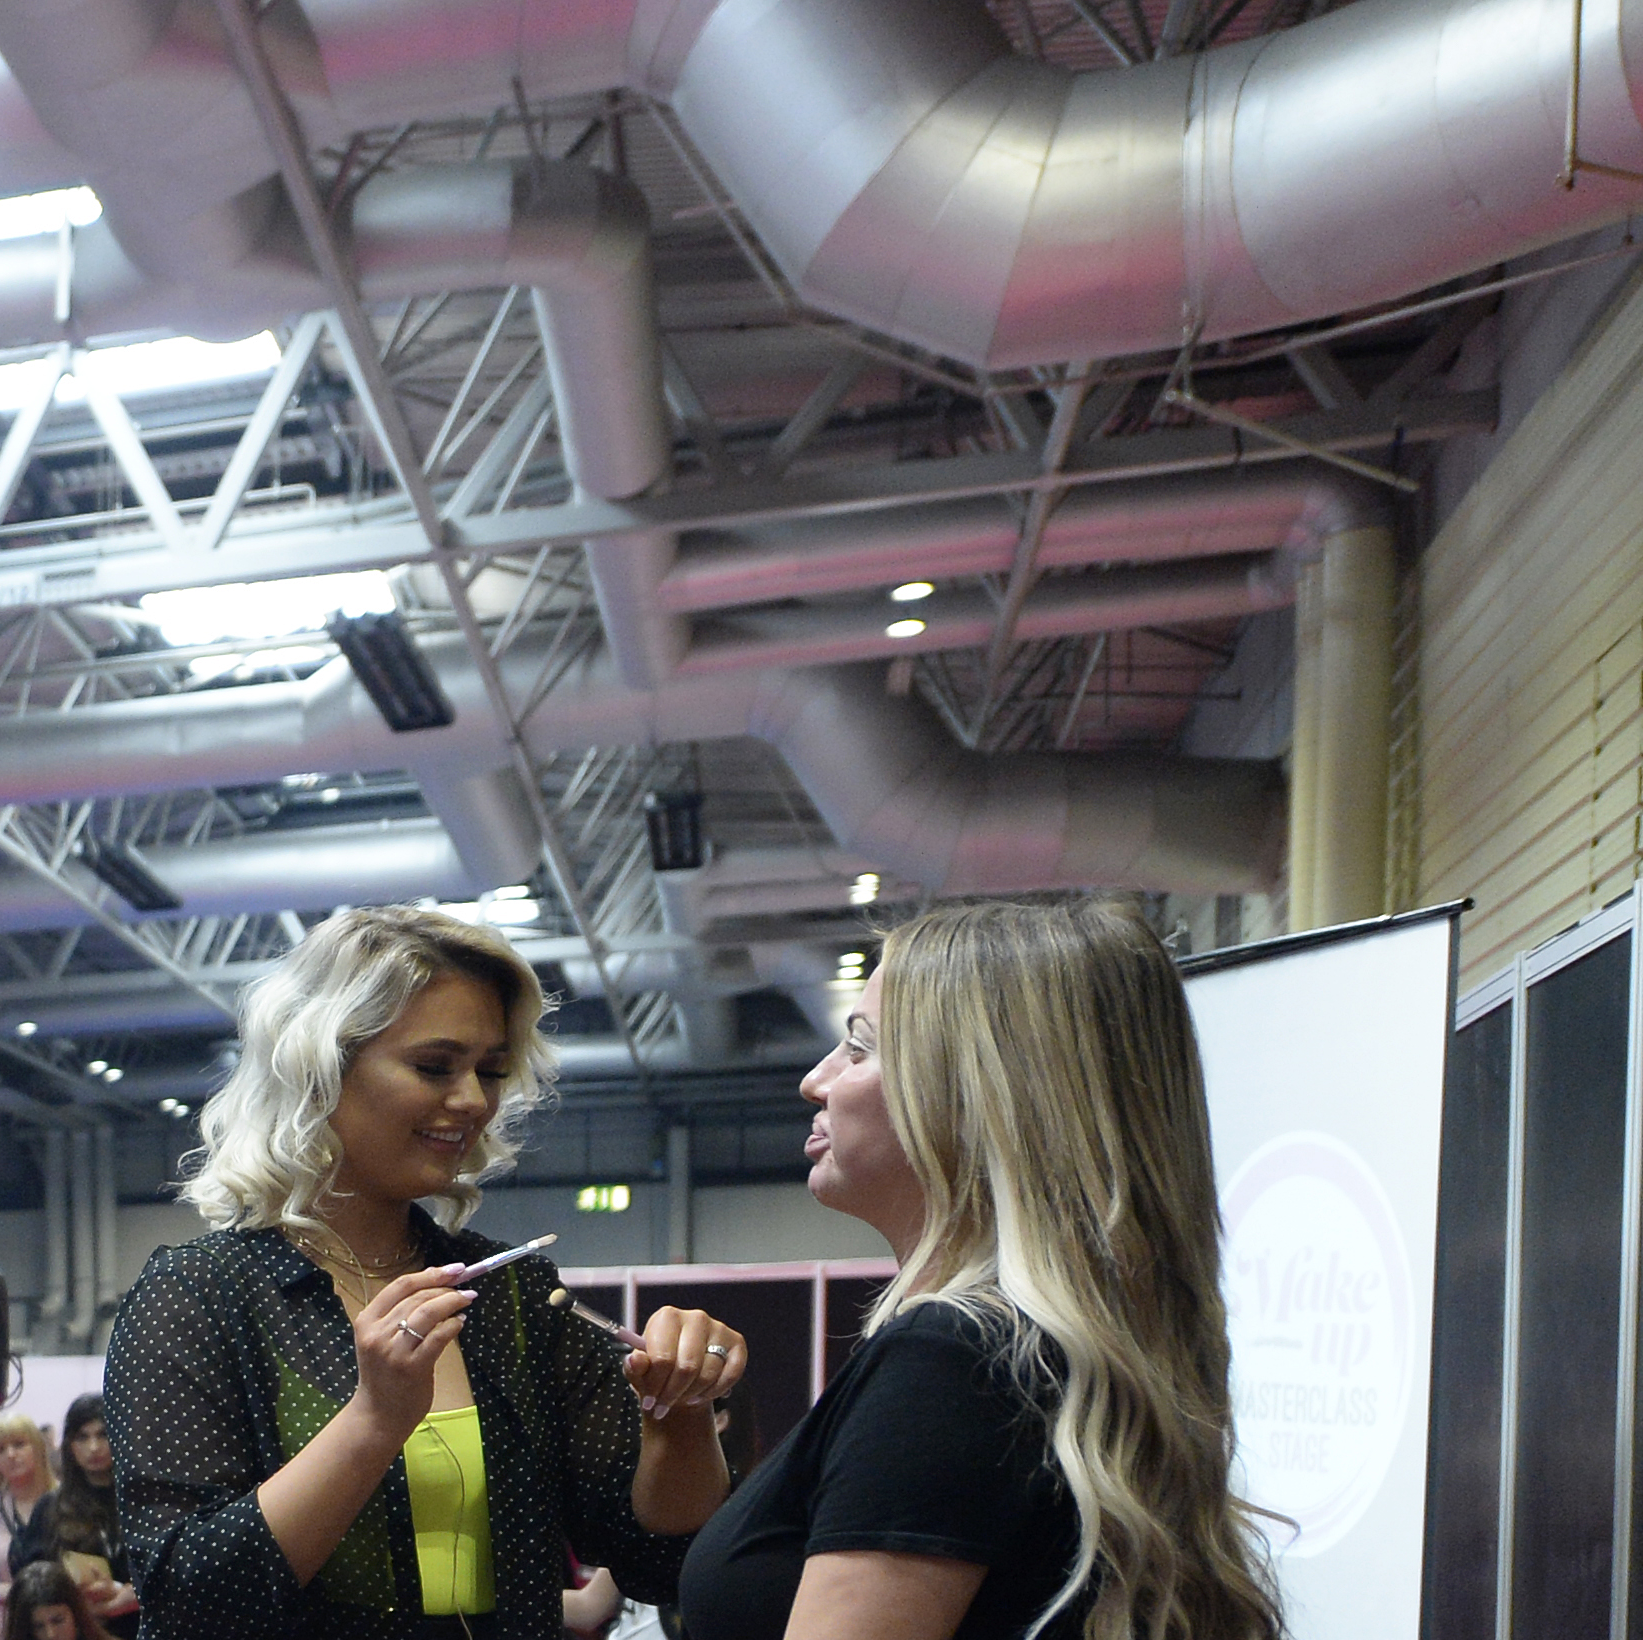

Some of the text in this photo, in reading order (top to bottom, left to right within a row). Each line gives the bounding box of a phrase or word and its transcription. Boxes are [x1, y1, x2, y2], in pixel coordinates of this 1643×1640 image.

[1228, 1245, 1382, 1323] Make
[1311, 1322, 1372, 1377] up
[1268, 1430, 1332, 1474] STAGE
